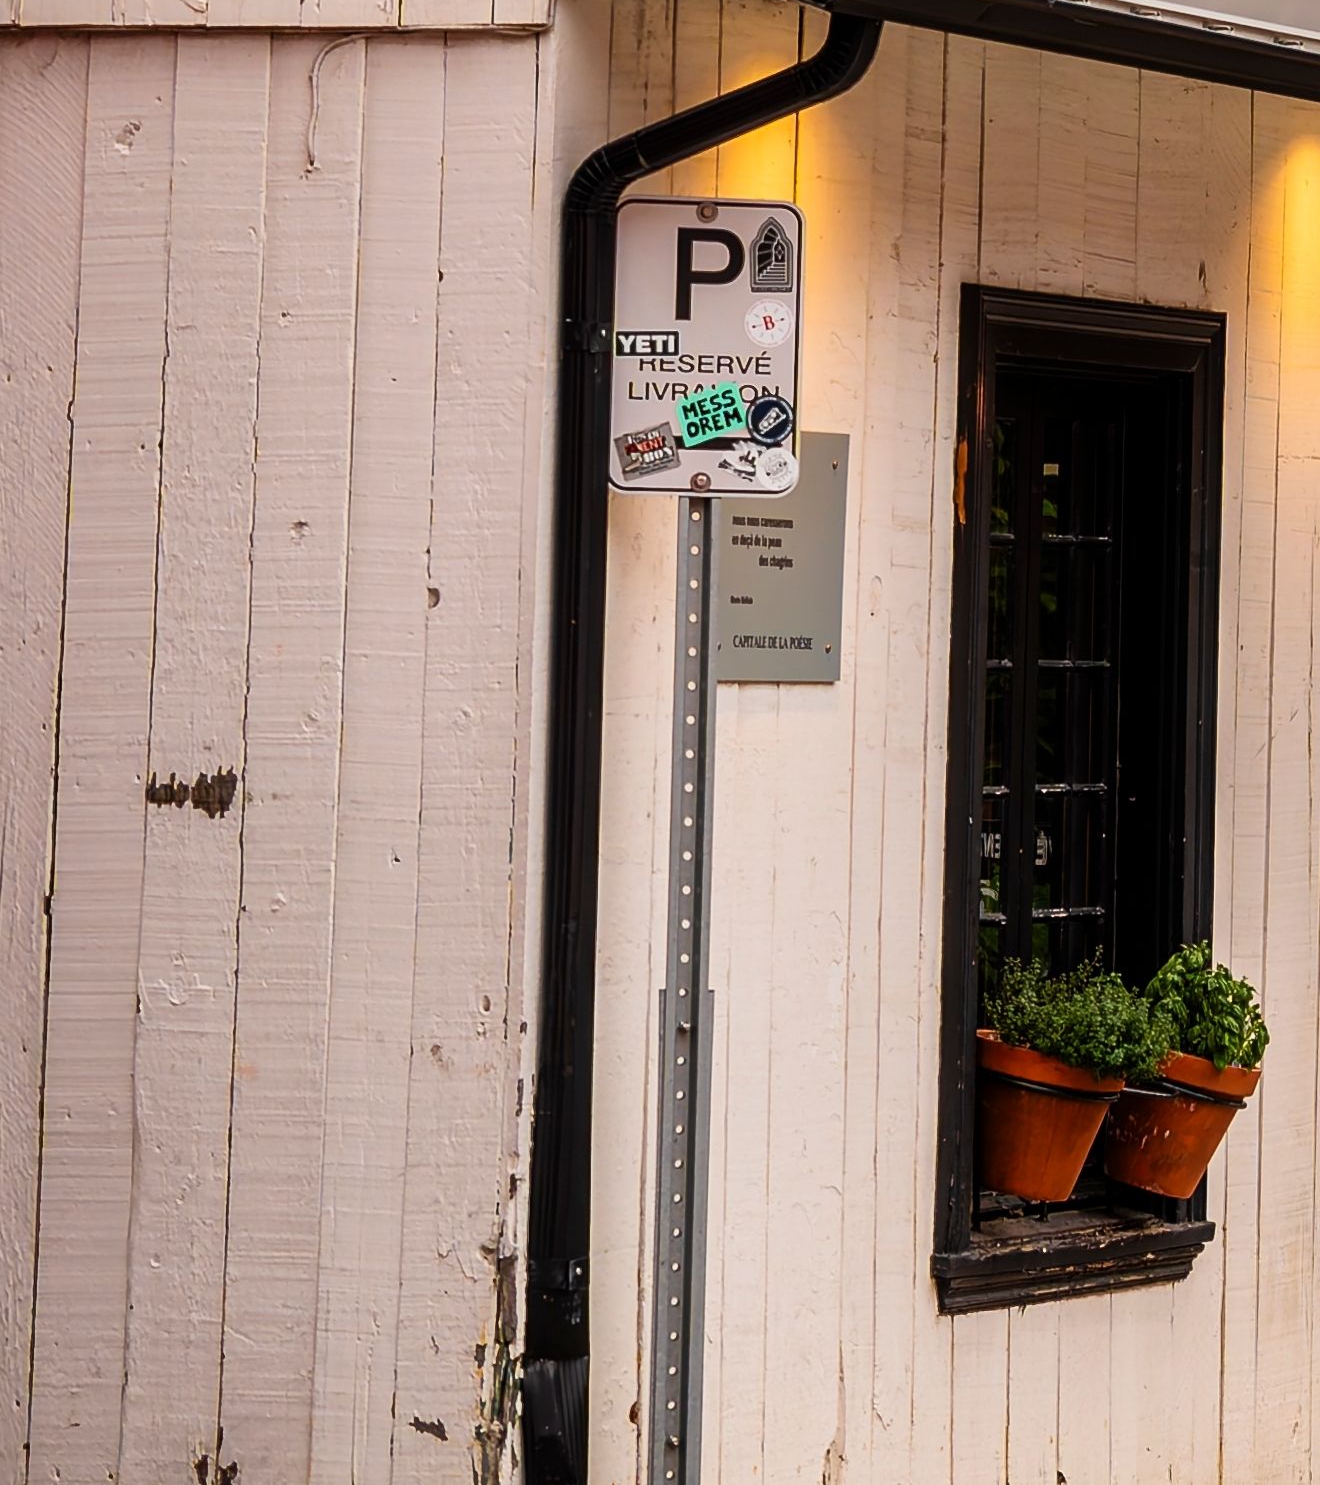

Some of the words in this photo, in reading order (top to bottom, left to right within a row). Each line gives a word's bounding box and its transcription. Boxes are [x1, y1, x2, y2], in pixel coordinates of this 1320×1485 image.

[674, 227, 746, 321] P
[618, 335, 675, 353] YETI
[681, 389, 737, 420] MESS
[686, 407, 743, 438] OREM
[733, 634, 767, 649] CAPITALE
[768, 636, 777, 649] DE
[779, 636, 788, 649] LA
[790, 634, 813, 650] POÉSIE
